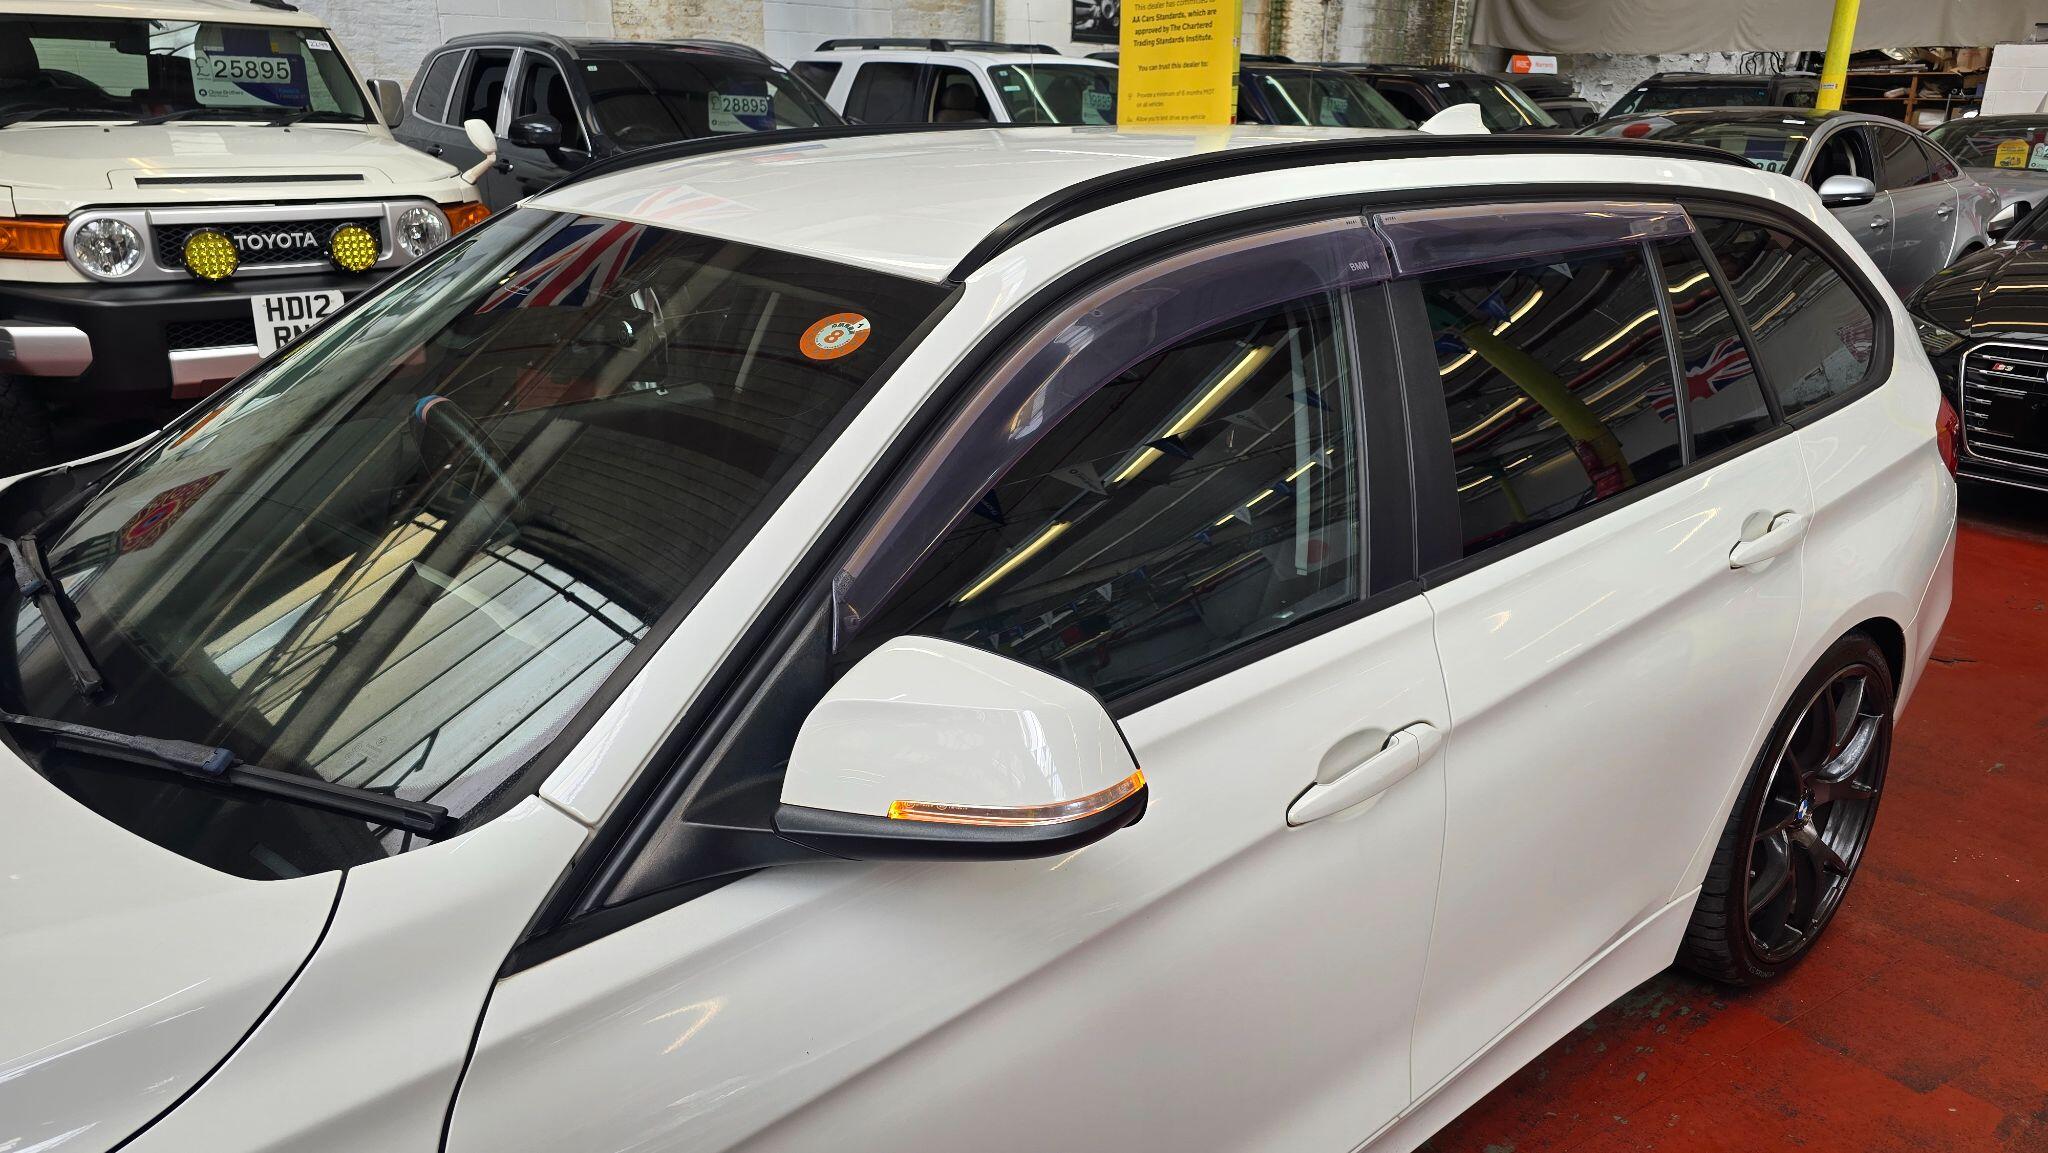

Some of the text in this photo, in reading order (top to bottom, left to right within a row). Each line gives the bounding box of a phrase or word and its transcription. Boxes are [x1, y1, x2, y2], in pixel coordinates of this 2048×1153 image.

[1148, 2, 1164, 10] dealer
[1156, 12, 1187, 21] Standards,
[1188, 9, 1206, 18] which
[1135, 26, 1162, 36] approved
[1162, 25, 1169, 33] by
[1182, 21, 1213, 31] Chartered
[1133, 34, 1213, 48] Trading Standards Institute.
[234, 232, 318, 250] TOYOTA
[1349, 260, 1370, 272] BMW
[265, 294, 331, 322] HD12
